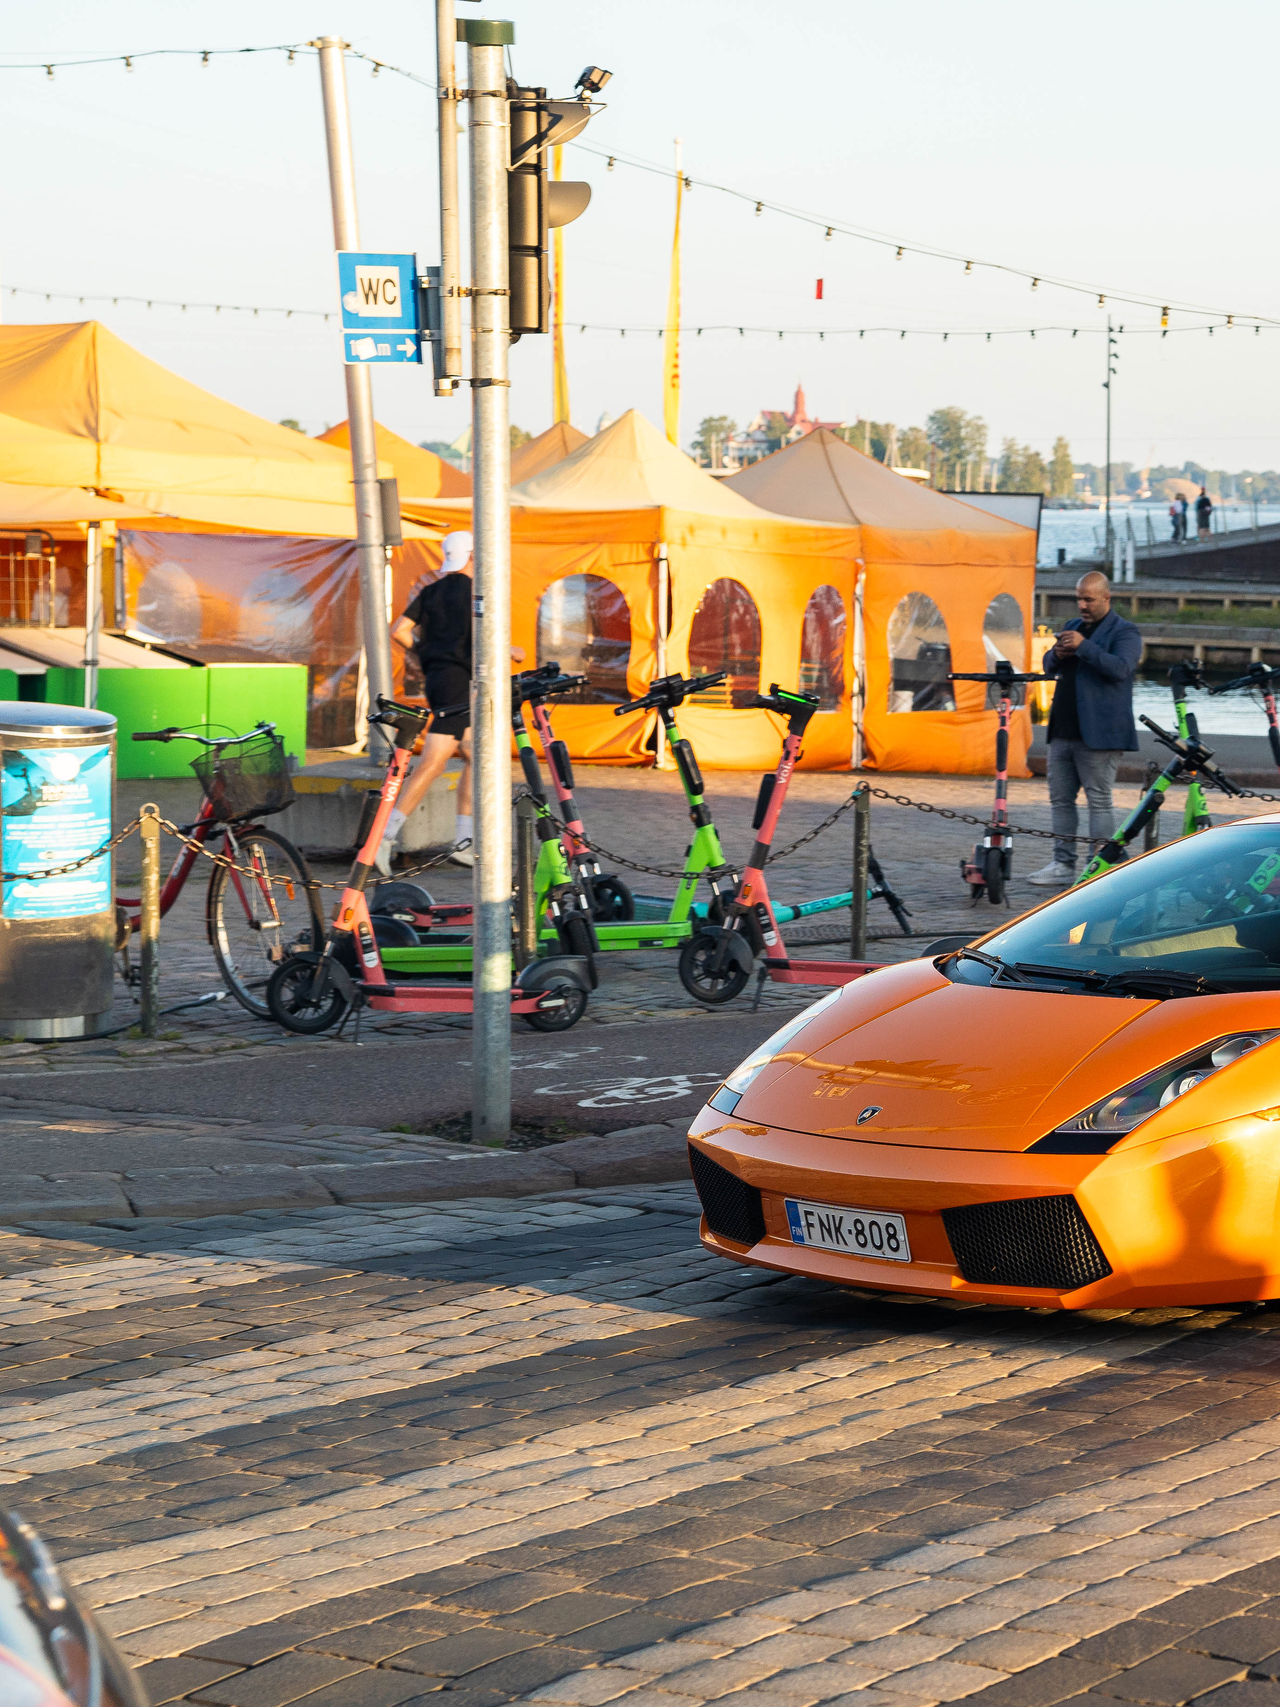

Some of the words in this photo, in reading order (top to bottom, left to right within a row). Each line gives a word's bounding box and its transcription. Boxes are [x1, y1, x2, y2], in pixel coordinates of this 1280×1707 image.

[360, 277, 397, 305] WC
[791, 1226, 803, 1237] FIN
[803, 1209, 900, 1252] FNK-808
